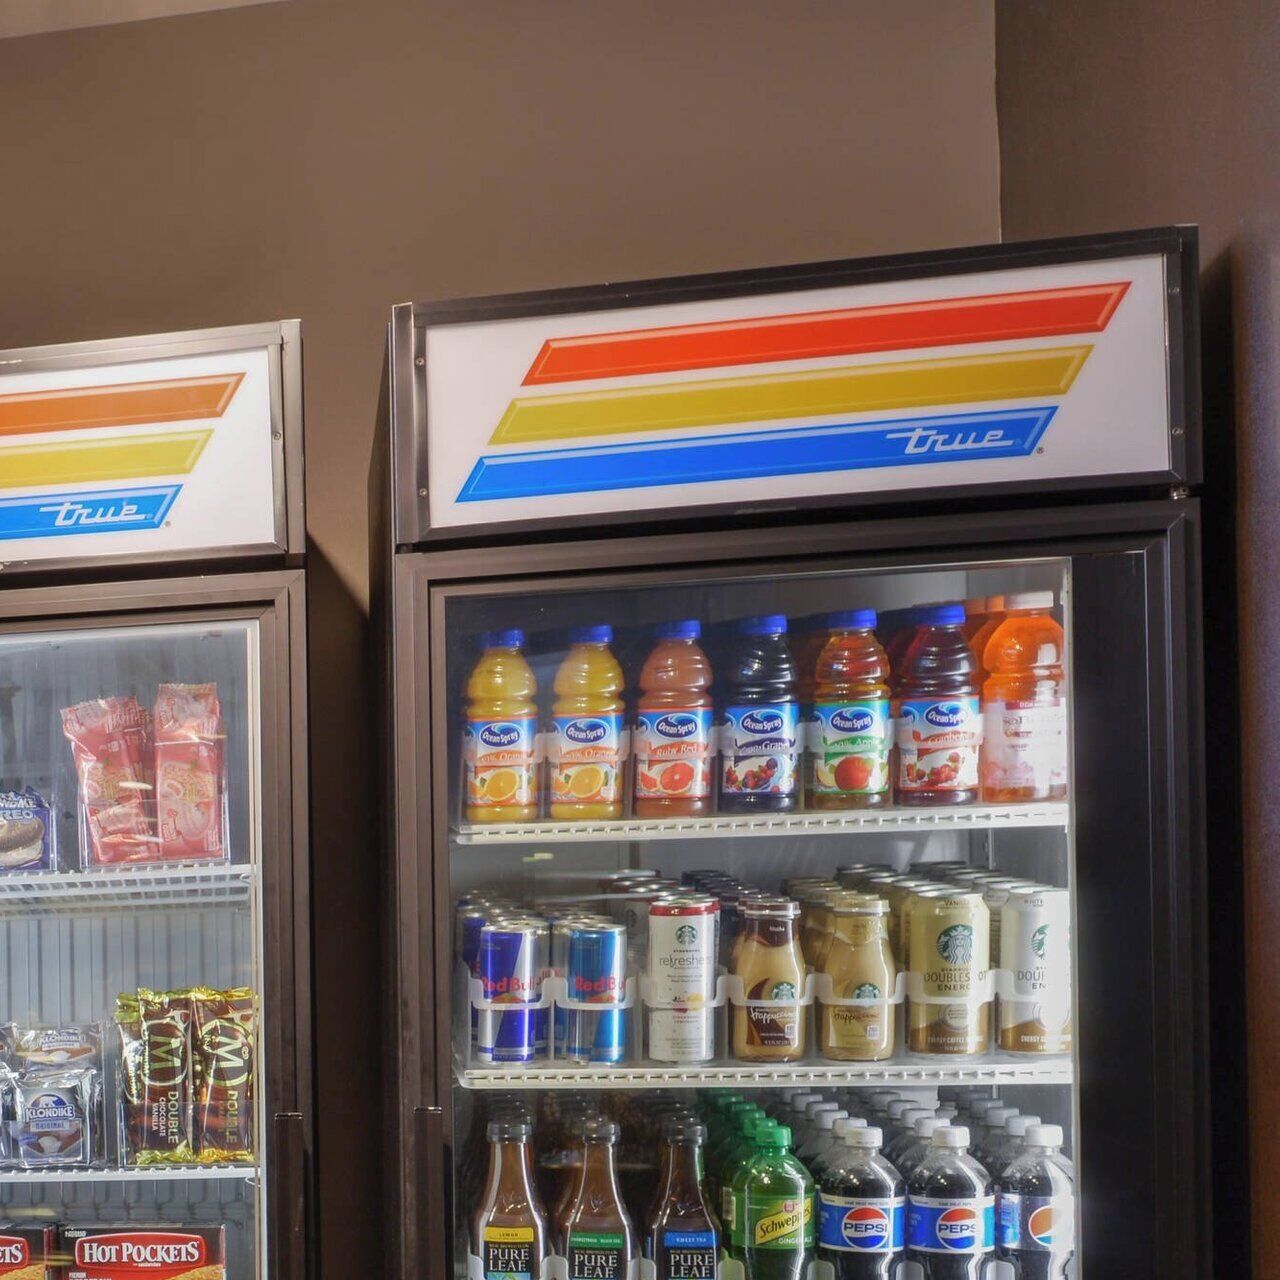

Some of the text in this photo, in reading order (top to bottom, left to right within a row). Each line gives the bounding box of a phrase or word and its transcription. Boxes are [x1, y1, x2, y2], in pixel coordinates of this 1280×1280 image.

[657, 721, 696, 736] Ocean Spray
[743, 718, 783, 732] Ocean Spray
[481, 730, 520, 744] Ocean Spray
[567, 725, 606, 740] Ocean Spray
[681, 743, 698, 754] Red
[481, 977, 536, 992] Red Bull
[575, 978, 601, 991] Red
[25, 1107, 74, 1117] KLONDIKE
[168, 1091, 179, 1144] DOUBLE
[226, 1090, 238, 1143] DOUBLE
[843, 1222, 888, 1233] PEPSI
[84, 1241, 199, 1264] HOT POCKETS
[490, 1249, 529, 1260] PURE
[490, 1260, 526, 1272] LEAF
[574, 1254, 618, 1266] PURE
[670, 1254, 714, 1266] PURE
[574, 1266, 614, 1278] LEAF
[670, 1266, 710, 1278] LEAF
